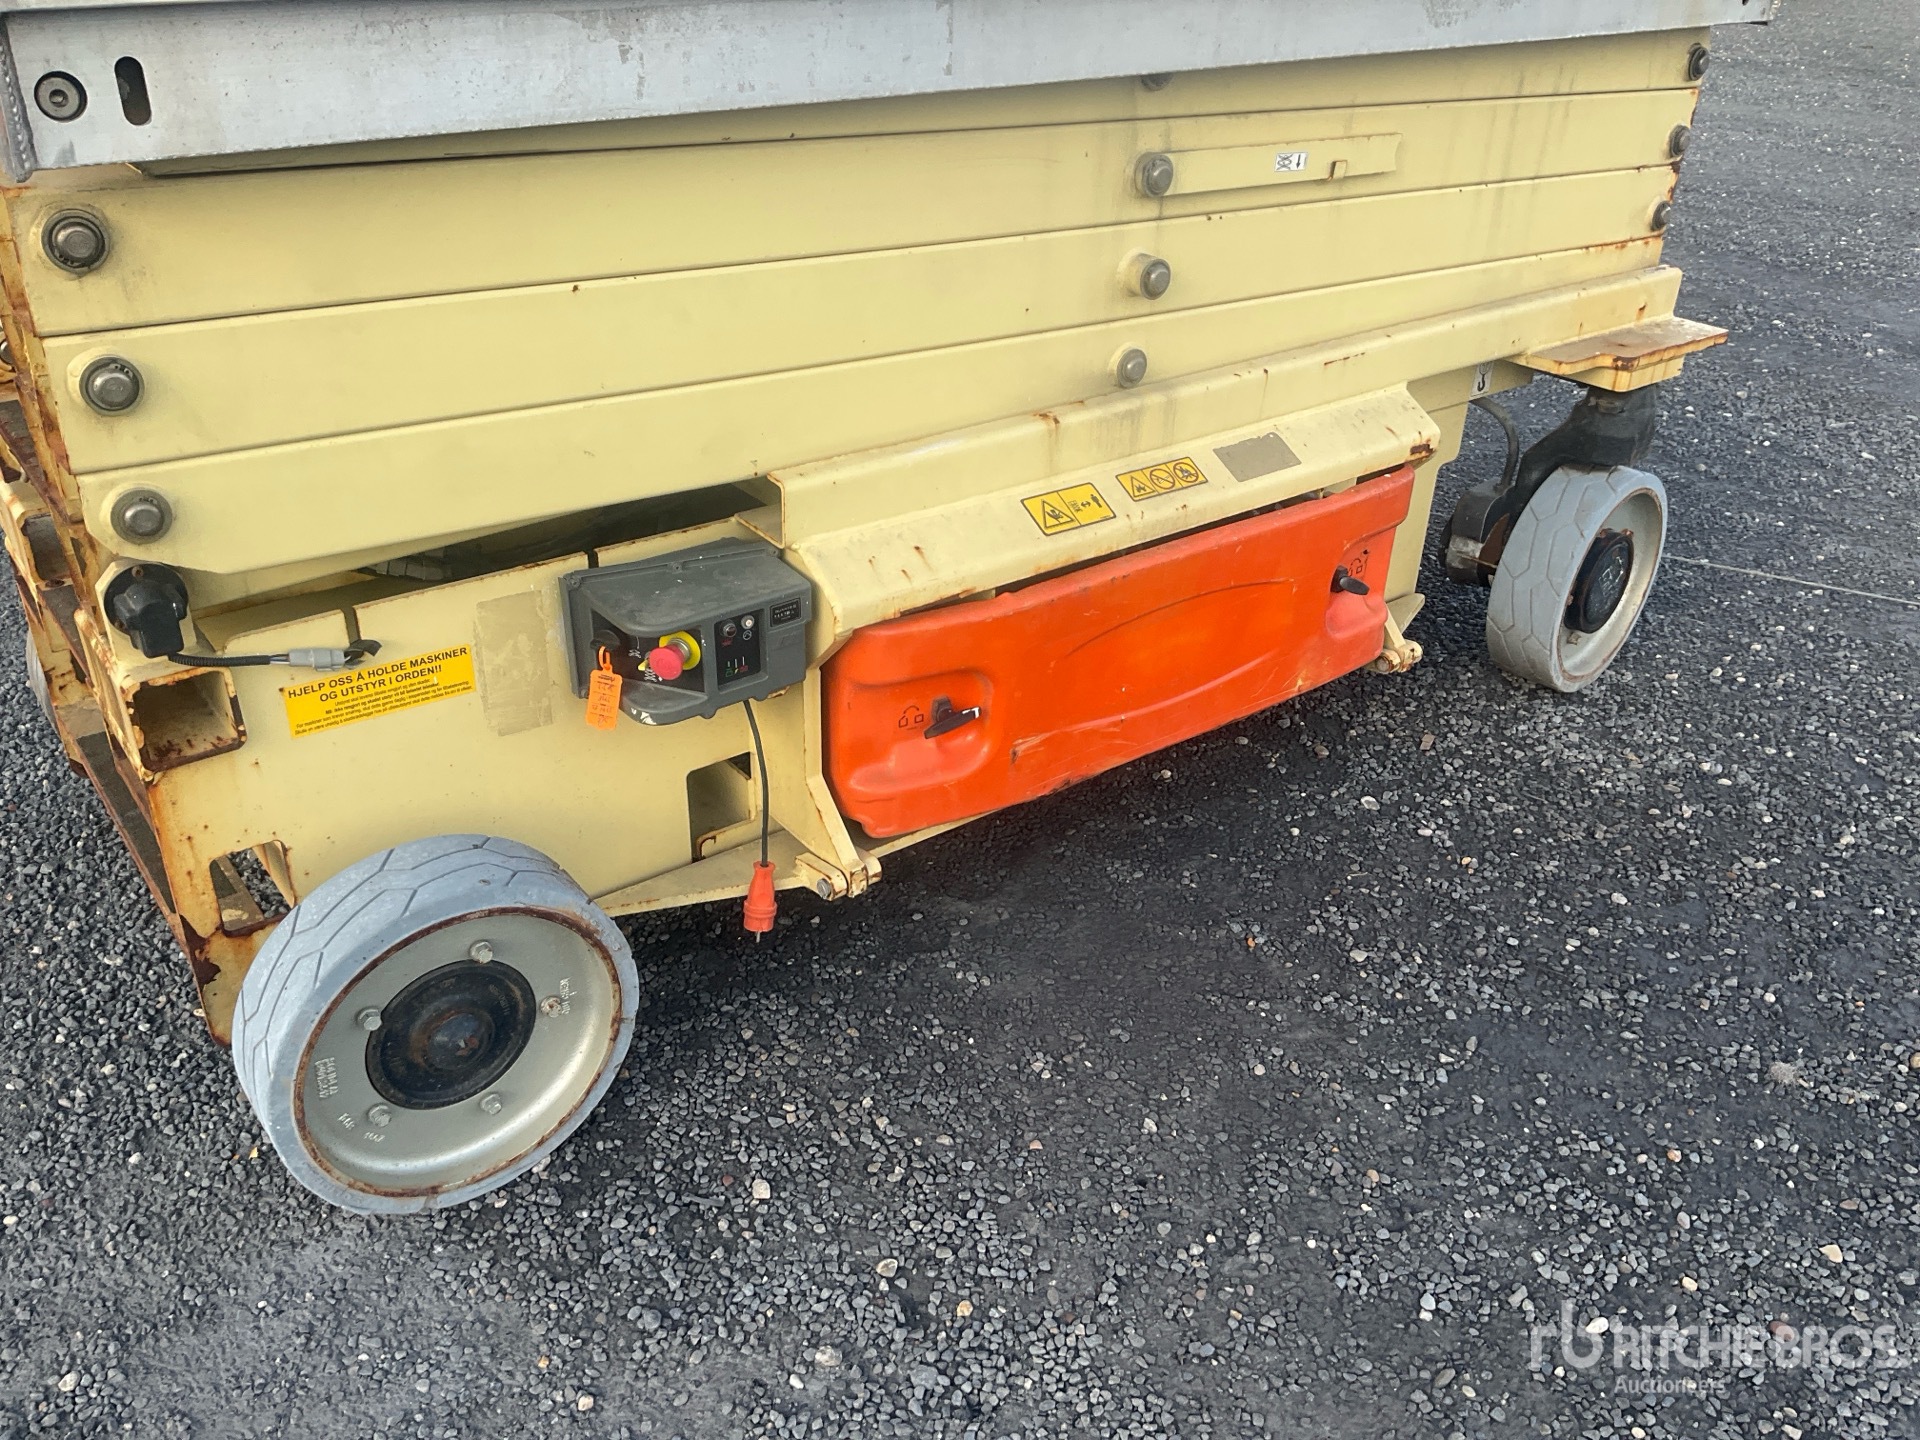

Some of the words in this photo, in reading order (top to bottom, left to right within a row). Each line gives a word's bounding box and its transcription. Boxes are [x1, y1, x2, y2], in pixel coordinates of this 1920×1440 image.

[288, 682, 326, 698] HJELP
[329, 675, 353, 687] OSS
[356, 670, 364, 681] Å
[368, 662, 407, 678] HOLDE
[410, 647, 467, 667] MASKINER
[320, 690, 337, 701] OG
[341, 678, 386, 696] UTSTYR
[395, 664, 442, 682] ORDEN!!
